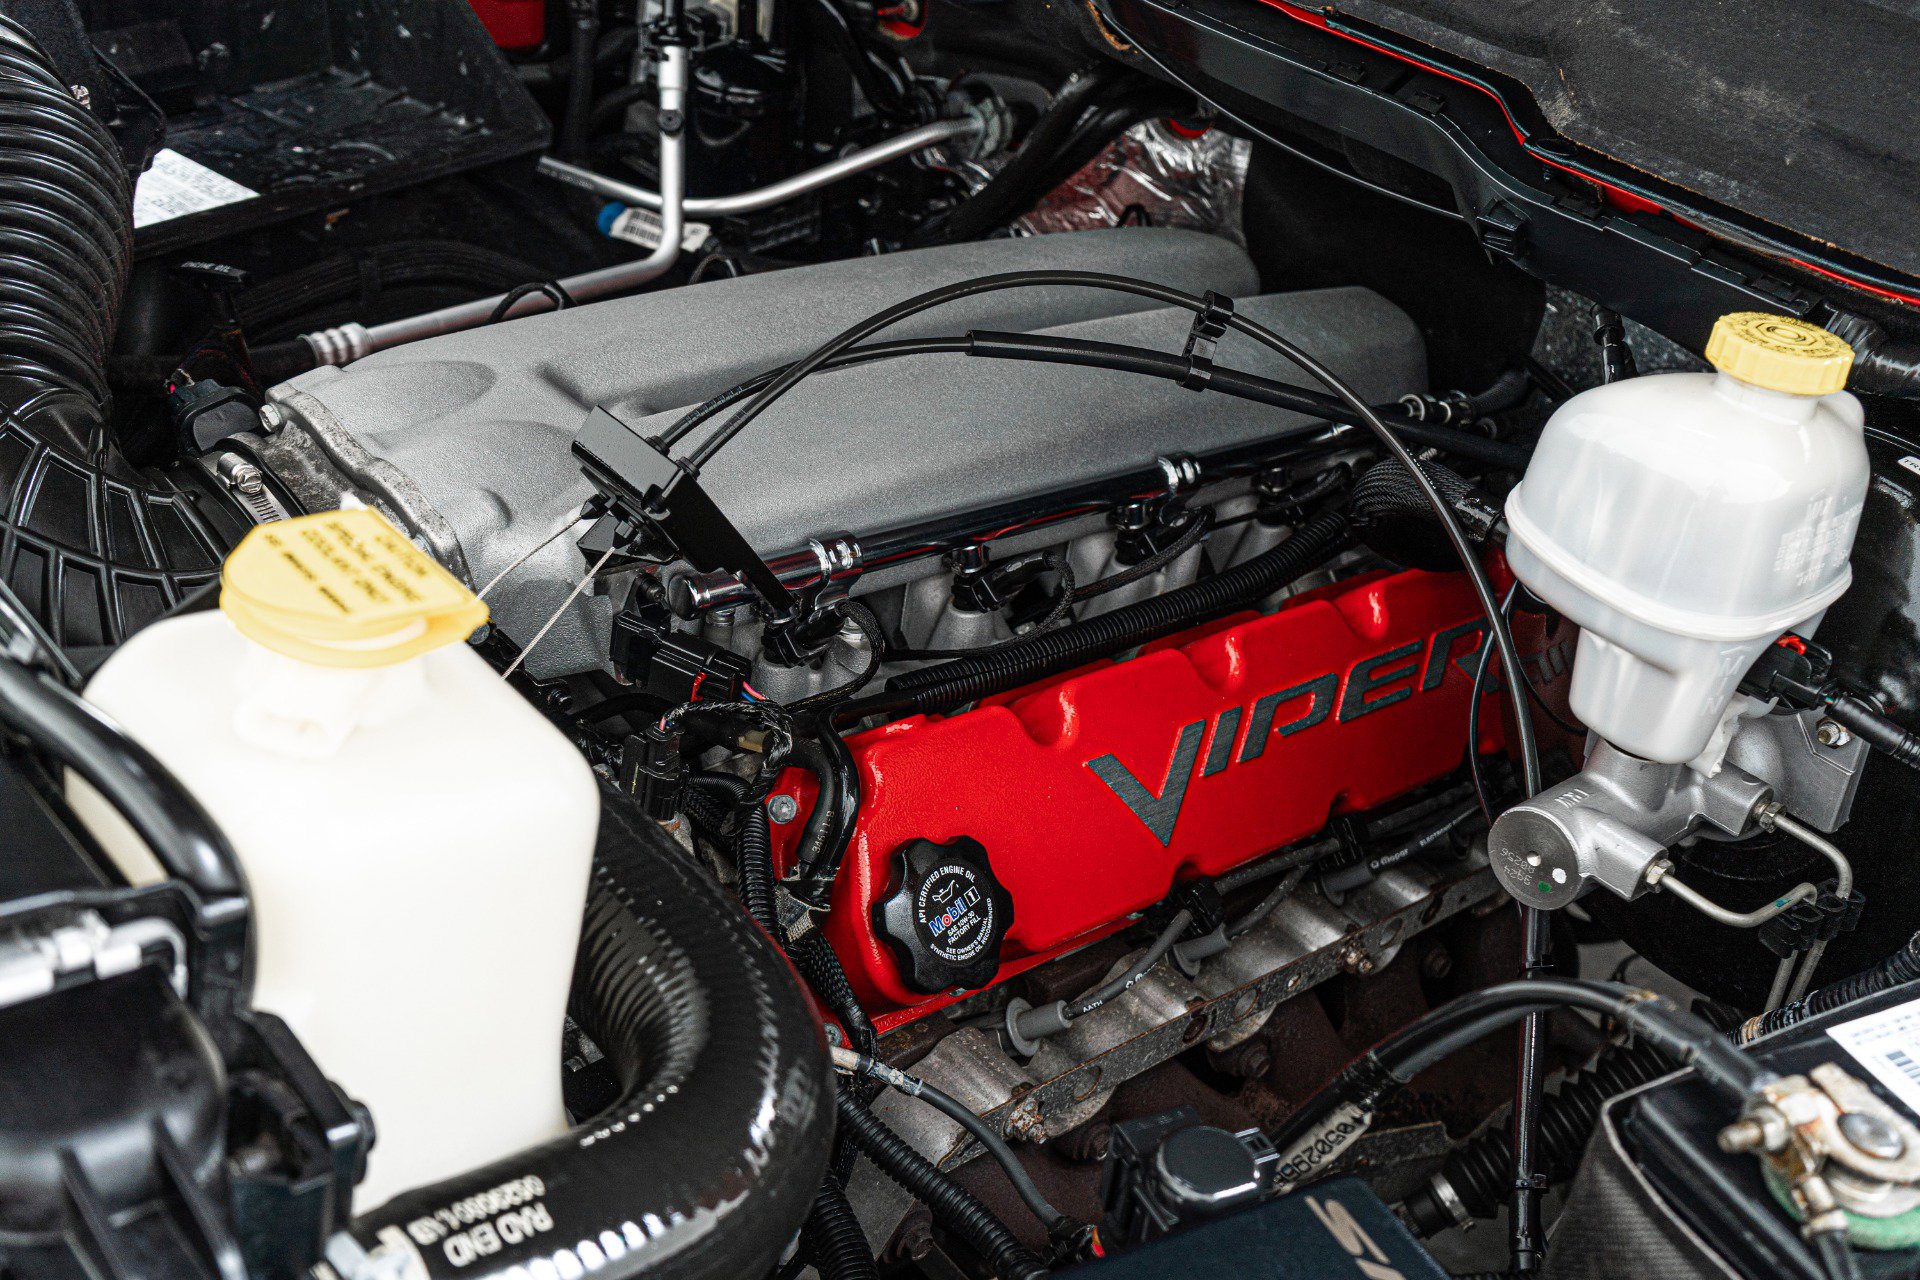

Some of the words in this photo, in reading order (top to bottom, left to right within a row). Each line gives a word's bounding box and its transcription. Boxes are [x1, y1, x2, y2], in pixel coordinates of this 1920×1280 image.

[1084, 613, 1503, 848] VIPER
[918, 870, 940, 907] CERTIFIED
[939, 865, 965, 876] ENGINE
[965, 870, 976, 883] OIL
[918, 909, 927, 924] API
[928, 896, 968, 938] Mobil
[947, 925, 971, 945] FACTORY
[969, 914, 982, 927] FILL
[929, 943, 957, 961] SYNTHETIC
[957, 950, 977, 961] ENGINE
[945, 946, 957, 955] SEE
[976, 917, 988, 942] MANUAL
[496, 1202, 555, 1244] RAD
[443, 1221, 503, 1268] END
